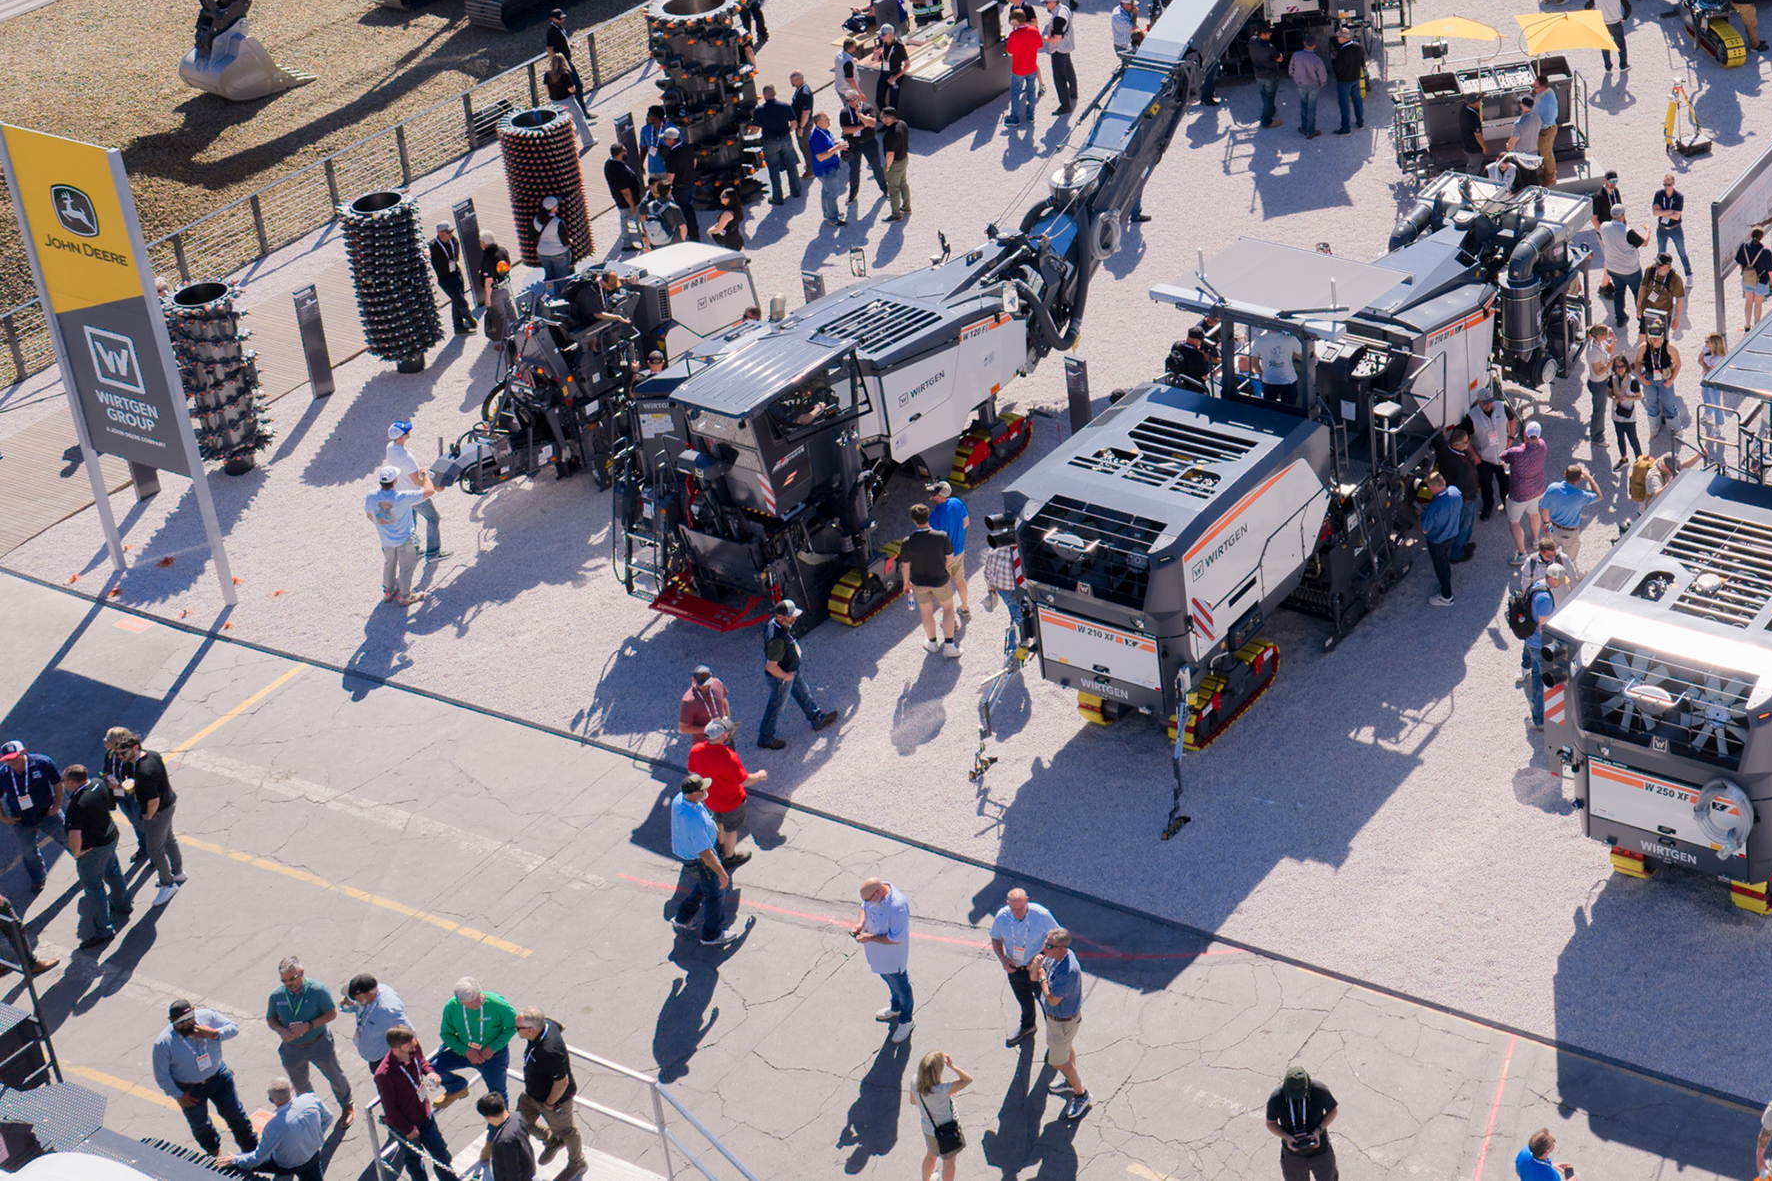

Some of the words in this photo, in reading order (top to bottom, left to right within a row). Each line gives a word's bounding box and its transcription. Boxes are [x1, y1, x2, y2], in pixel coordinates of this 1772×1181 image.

[1221, 6, 1240, 31] WIRTGEN
[45, 234, 82, 254] JOHN
[83, 243, 129, 267] DEERE
[683, 283, 690, 291] W
[690, 279, 699, 288] 60
[708, 283, 743, 304] WIRTGEN
[963, 333, 969, 341] W
[970, 327, 981, 339] 120
[910, 370, 945, 398] WIRTGEN
[95, 389, 159, 419] WIRTGEN
[643, 402, 670, 410] WIRTG
[106, 407, 156, 431] GROUP
[140, 435, 166, 447] COMPANY
[1205, 523, 1248, 567] WIRTGEN
[1077, 625, 1086, 634] W
[1087, 628, 1102, 639] 210
[1104, 632, 1115, 642] XF
[1080, 677, 1129, 700] WIRTGEN
[1644, 782, 1655, 793] W
[1656, 786, 1675, 797] 250
[1676, 791, 1690, 803] XF
[1640, 840, 1697, 864] WIRTGEN
